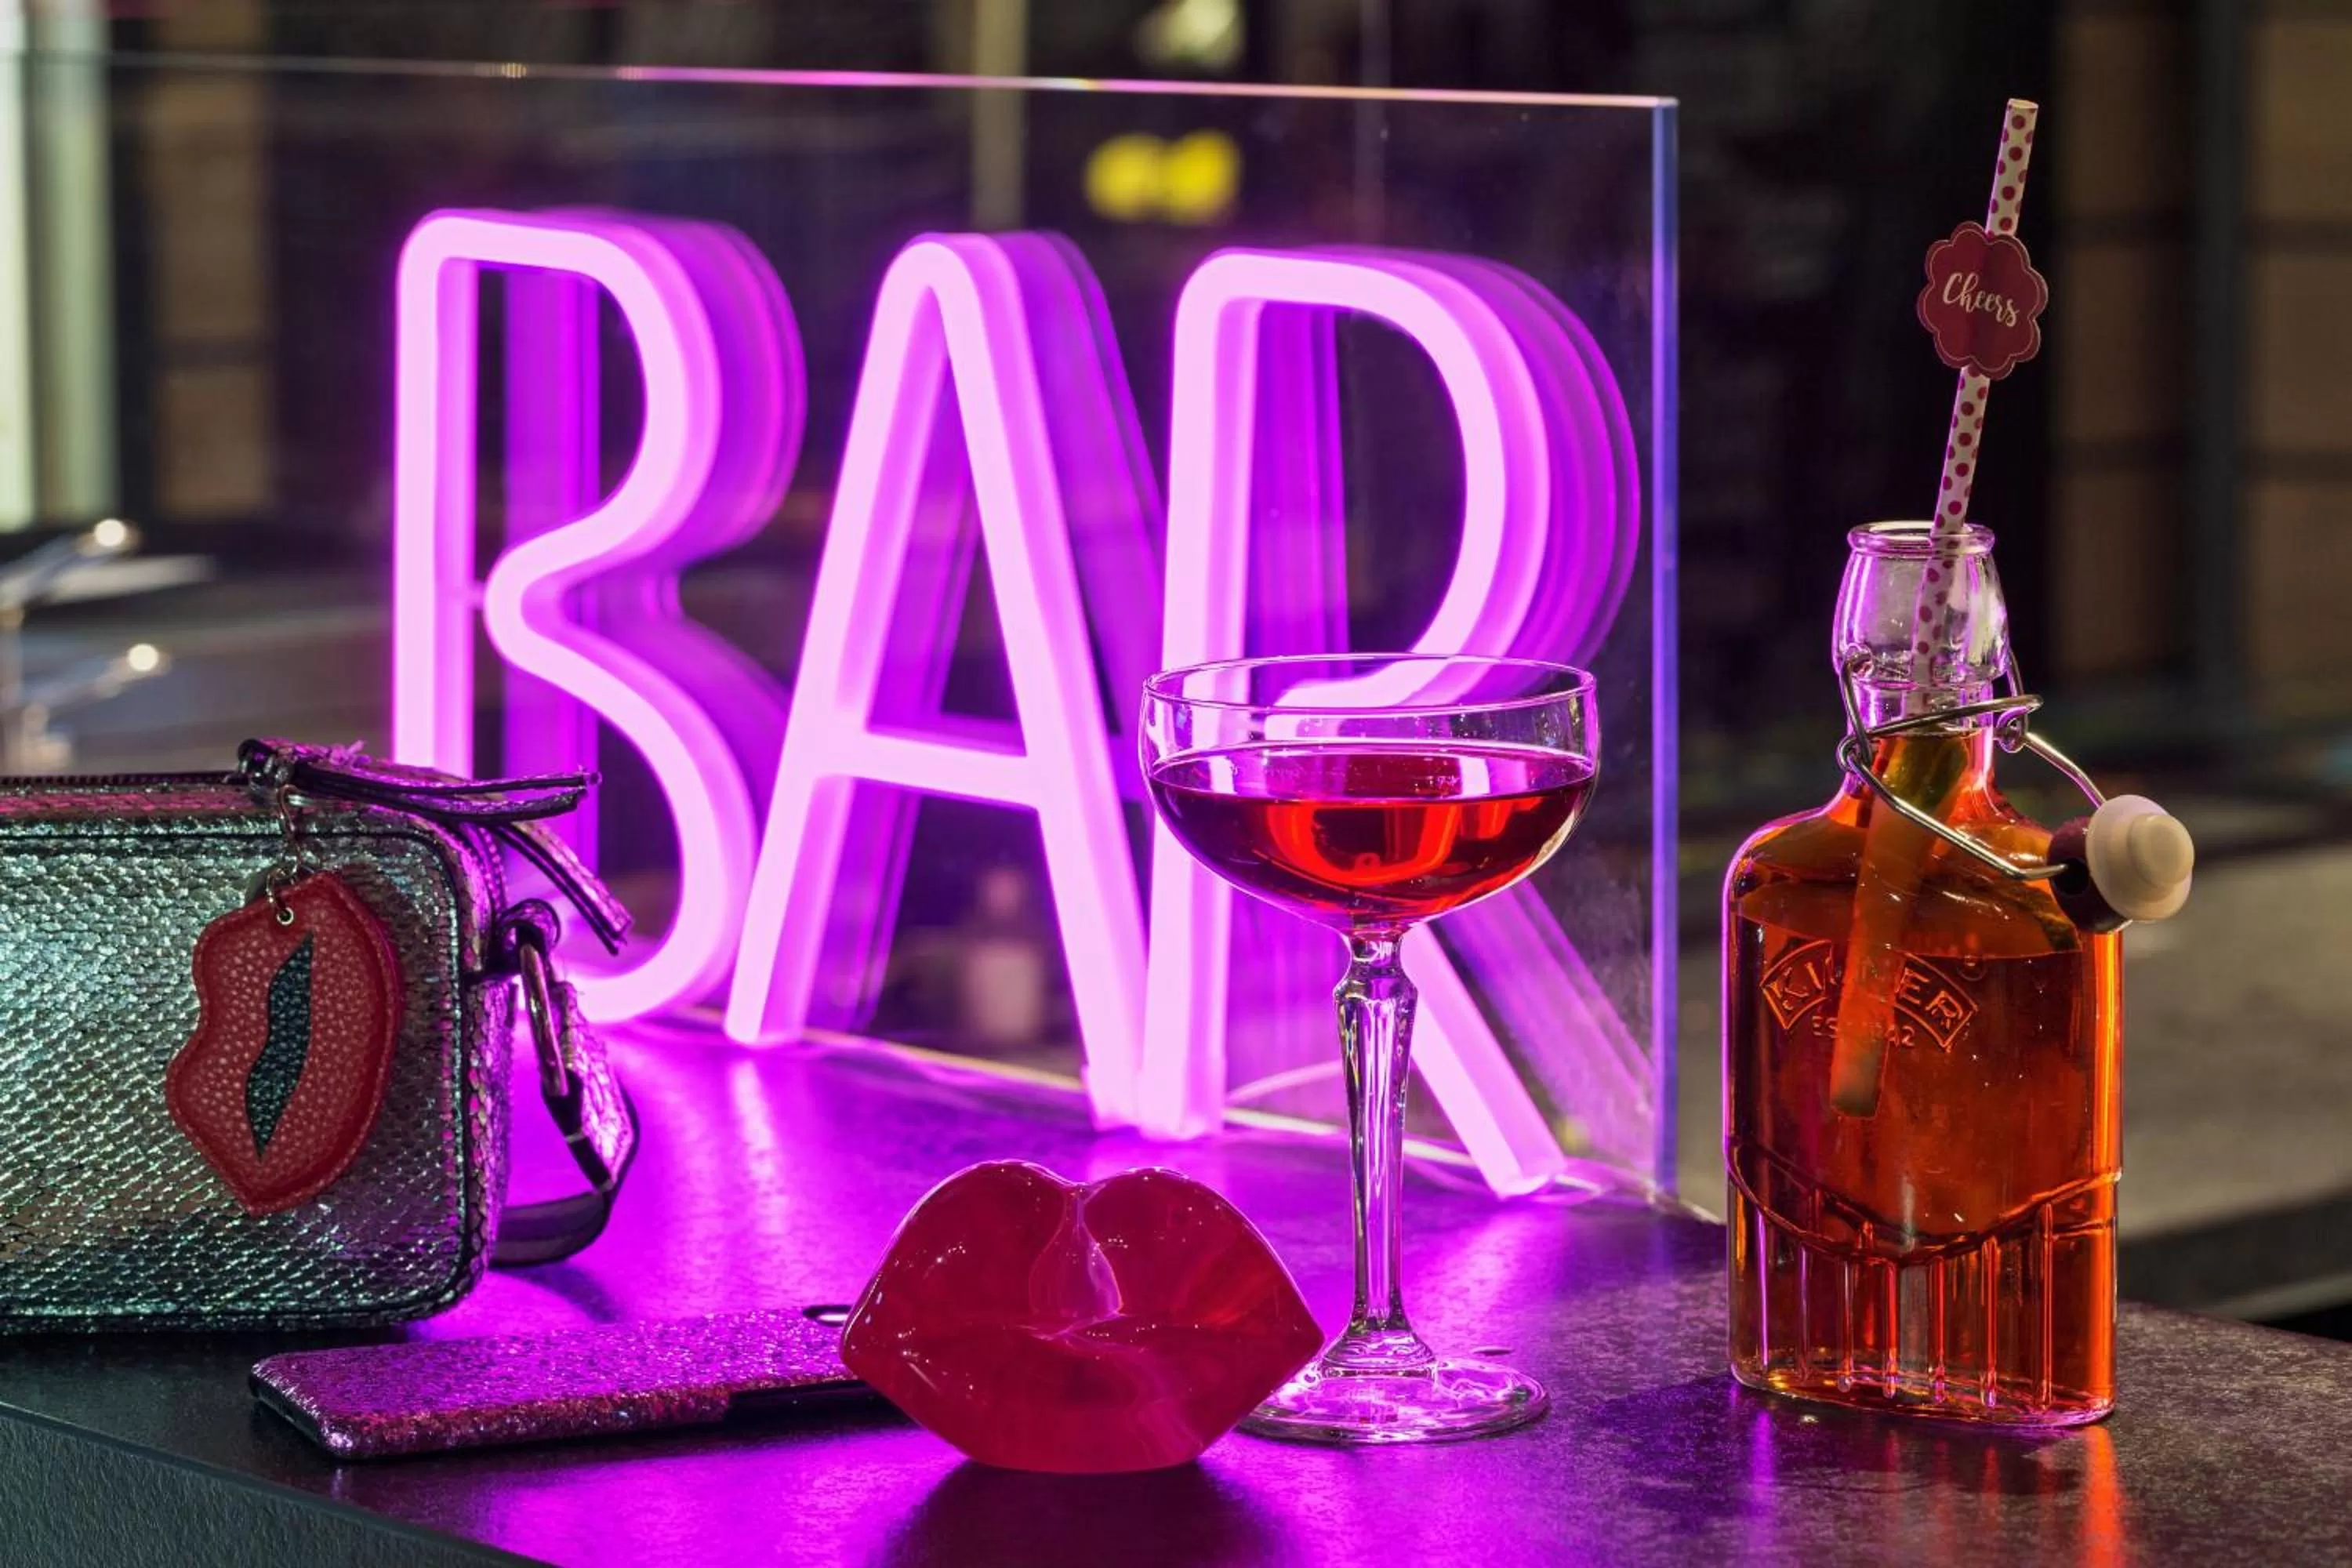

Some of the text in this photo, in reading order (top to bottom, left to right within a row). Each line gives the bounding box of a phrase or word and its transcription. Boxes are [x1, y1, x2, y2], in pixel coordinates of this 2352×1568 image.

[1943, 273, 2020, 327] Cheers
[392, 210, 1568, 1198] BAR
[1768, 953, 1965, 1030] KIER
